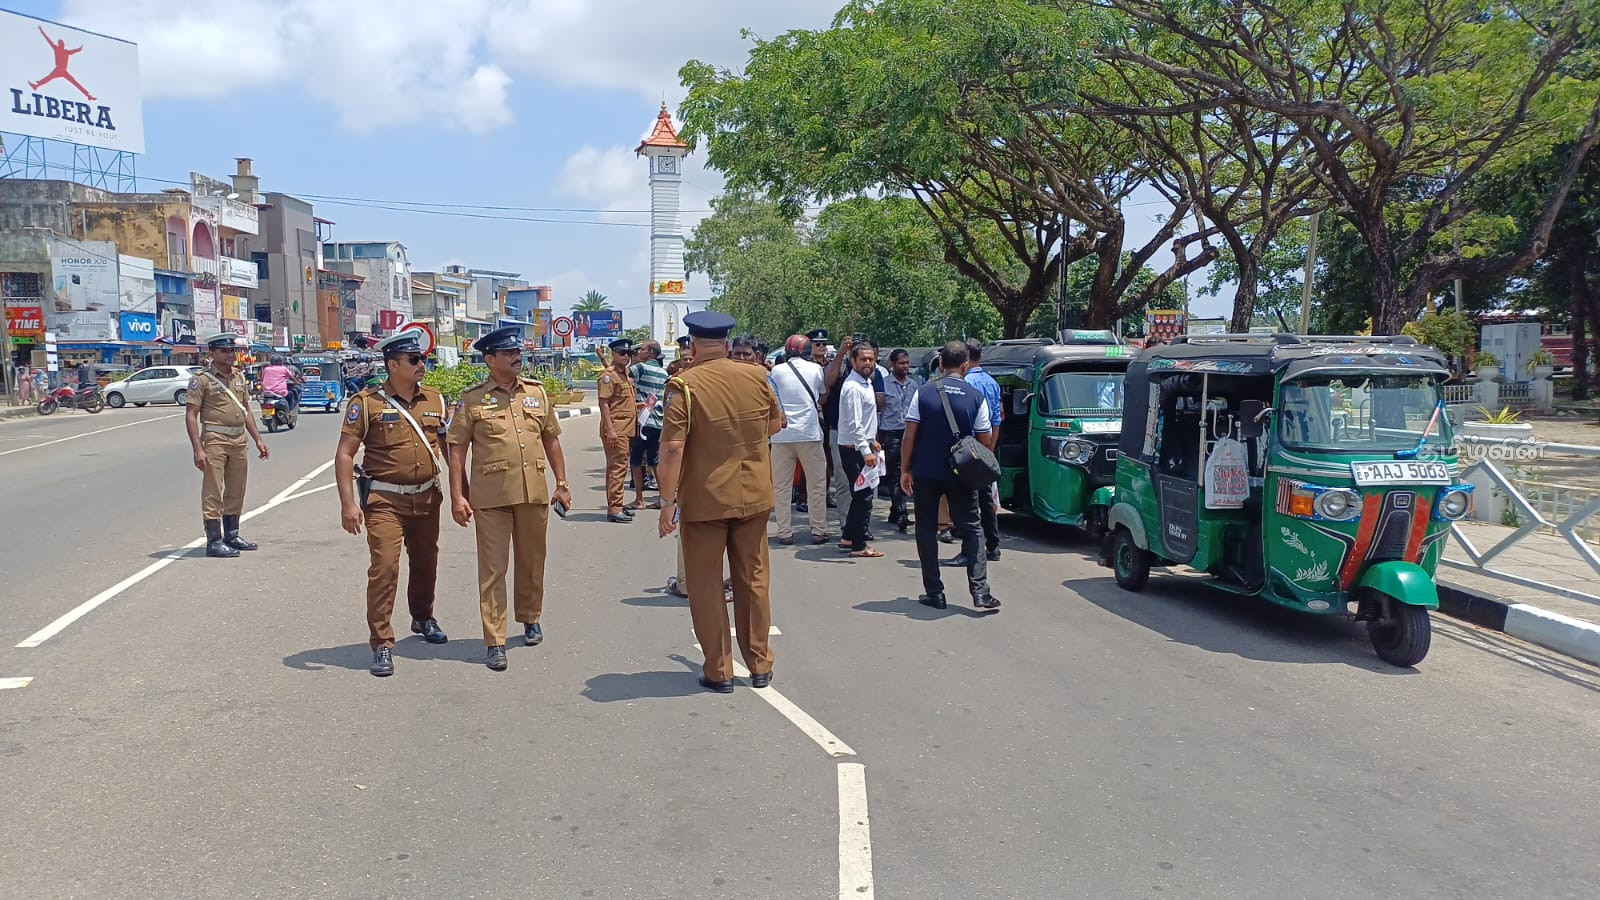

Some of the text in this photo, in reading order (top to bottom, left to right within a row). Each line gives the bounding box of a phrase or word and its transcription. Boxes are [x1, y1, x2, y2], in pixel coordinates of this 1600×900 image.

[10, 88, 116, 130] LIBERA
[61, 257, 92, 265] HONOR
[15, 319, 40, 329] TIME
[128, 318, 151, 333] vivo
[1373, 464, 1404, 480] AAJ
